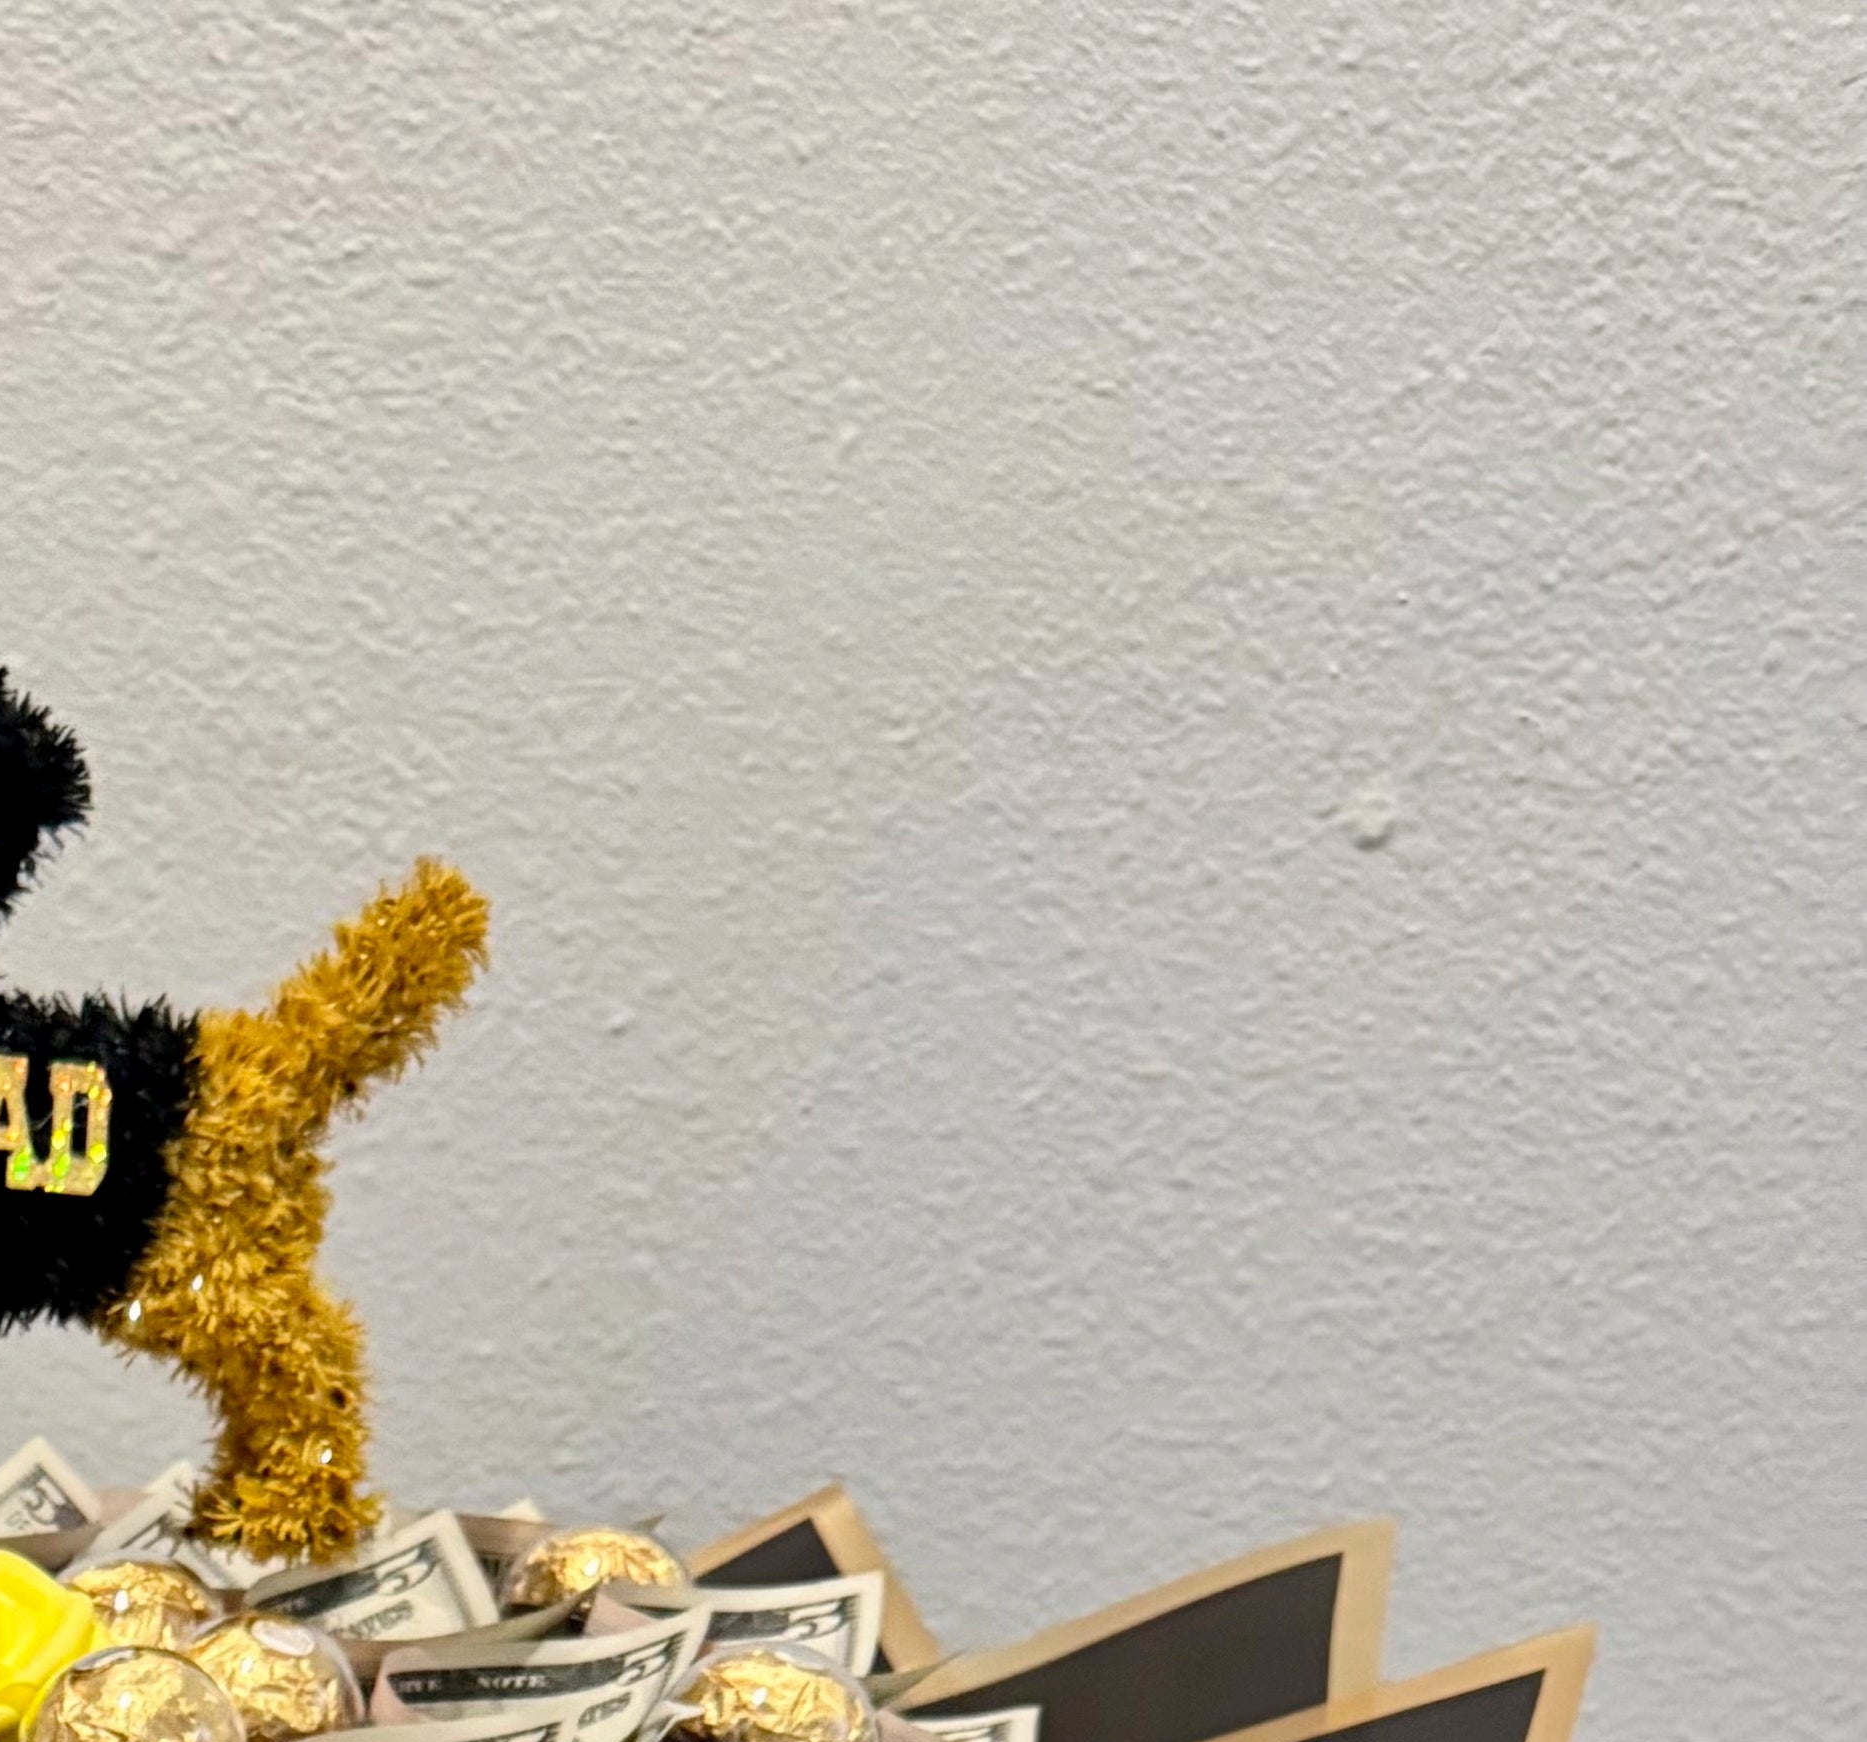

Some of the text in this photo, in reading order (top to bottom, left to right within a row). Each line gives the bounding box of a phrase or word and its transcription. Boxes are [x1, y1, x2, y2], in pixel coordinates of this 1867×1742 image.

[376, 1545, 436, 1596] 5
[787, 1603, 845, 1638] 5
[620, 1640, 673, 1687] 5
